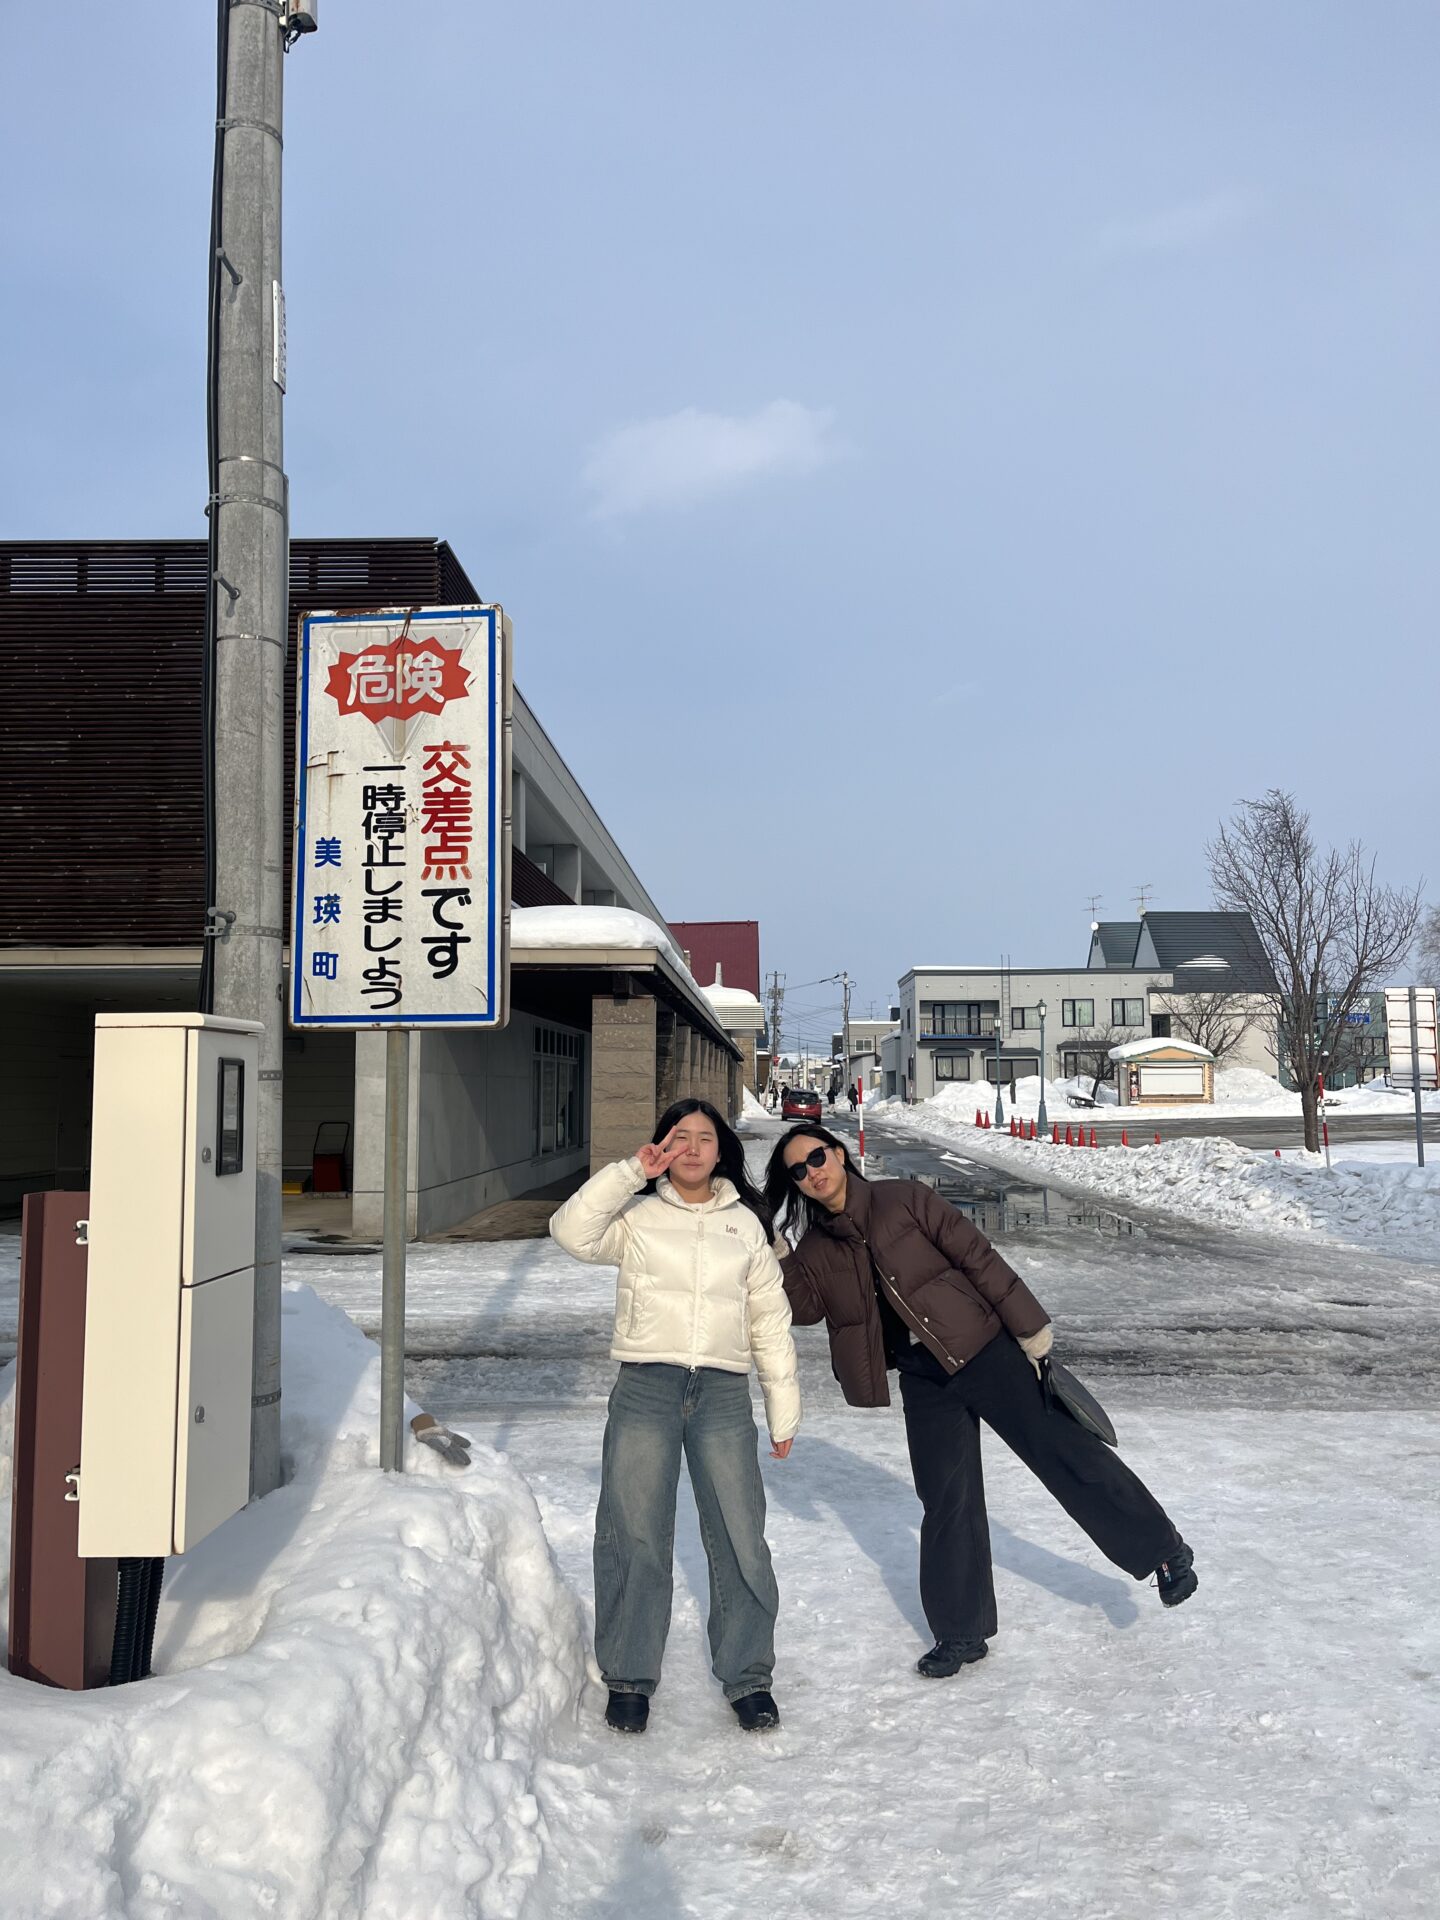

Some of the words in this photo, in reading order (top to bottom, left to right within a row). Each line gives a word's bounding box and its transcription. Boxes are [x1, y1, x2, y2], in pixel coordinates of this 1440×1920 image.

[346, 651, 446, 706] 危険
[312, 836, 343, 981] 美瑛町
[360, 763, 407, 1010] 一時停止しましょう
[420, 739, 473, 980] 交差点です
[725, 1224, 738, 1235] Lee
